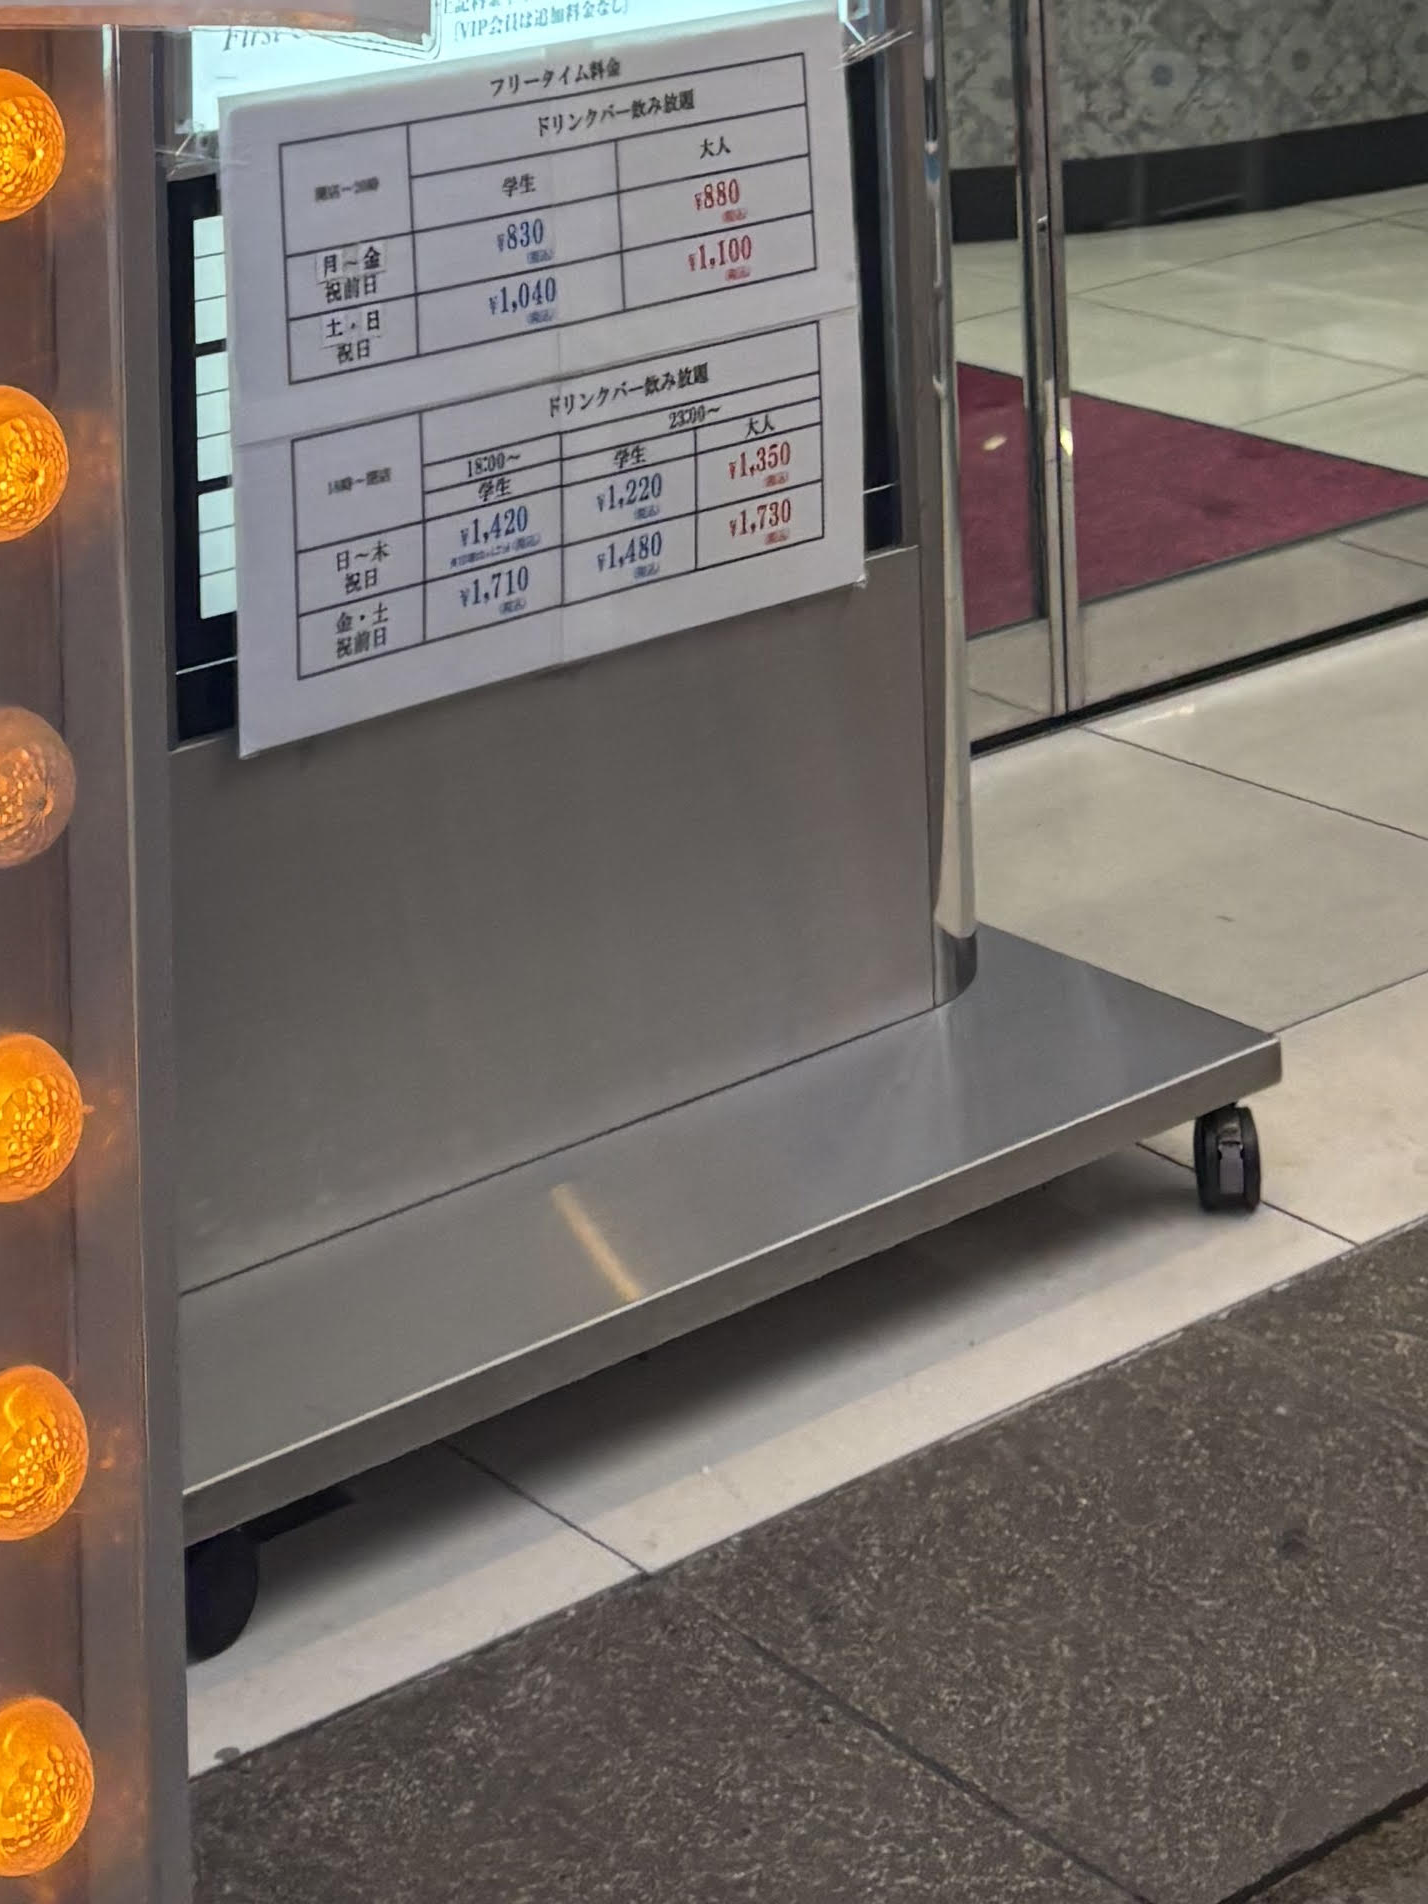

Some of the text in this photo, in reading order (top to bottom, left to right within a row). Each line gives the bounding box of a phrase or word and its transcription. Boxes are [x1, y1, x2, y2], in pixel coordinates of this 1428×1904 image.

[490, 56, 622, 98] フリータイム料金
[538, 88, 696, 137] ドリンクバー飲み放題
[699, 136, 731, 159] 大人
[502, 173, 537, 196] 学生
[694, 179, 741, 211] ¥880
[497, 217, 545, 251] ¥830
[323, 246, 381, 275] 月～金
[688, 235, 753, 272] ¥1,100
[324, 275, 378, 304] 祝前日
[489, 277, 557, 314] ¥1,040
[337, 338, 371, 365] 祝日
[548, 362, 709, 418] ドリンクバー飲み放題
[744, 413, 776, 438] 大人
[467, 451, 522, 477] 18:00～
[614, 444, 647, 468] 学生
[728, 442, 791, 480] ¥1,350
[596, 473, 663, 514] ¥1,220
[460, 505, 529, 547] ¥1,420
[729, 498, 792, 538] ¥1,730
[596, 532, 663, 573] ¥1,480
[344, 566, 378, 595] 祝日
[459, 566, 530, 608] ¥1,710
[335, 627, 388, 659] 祝前日
